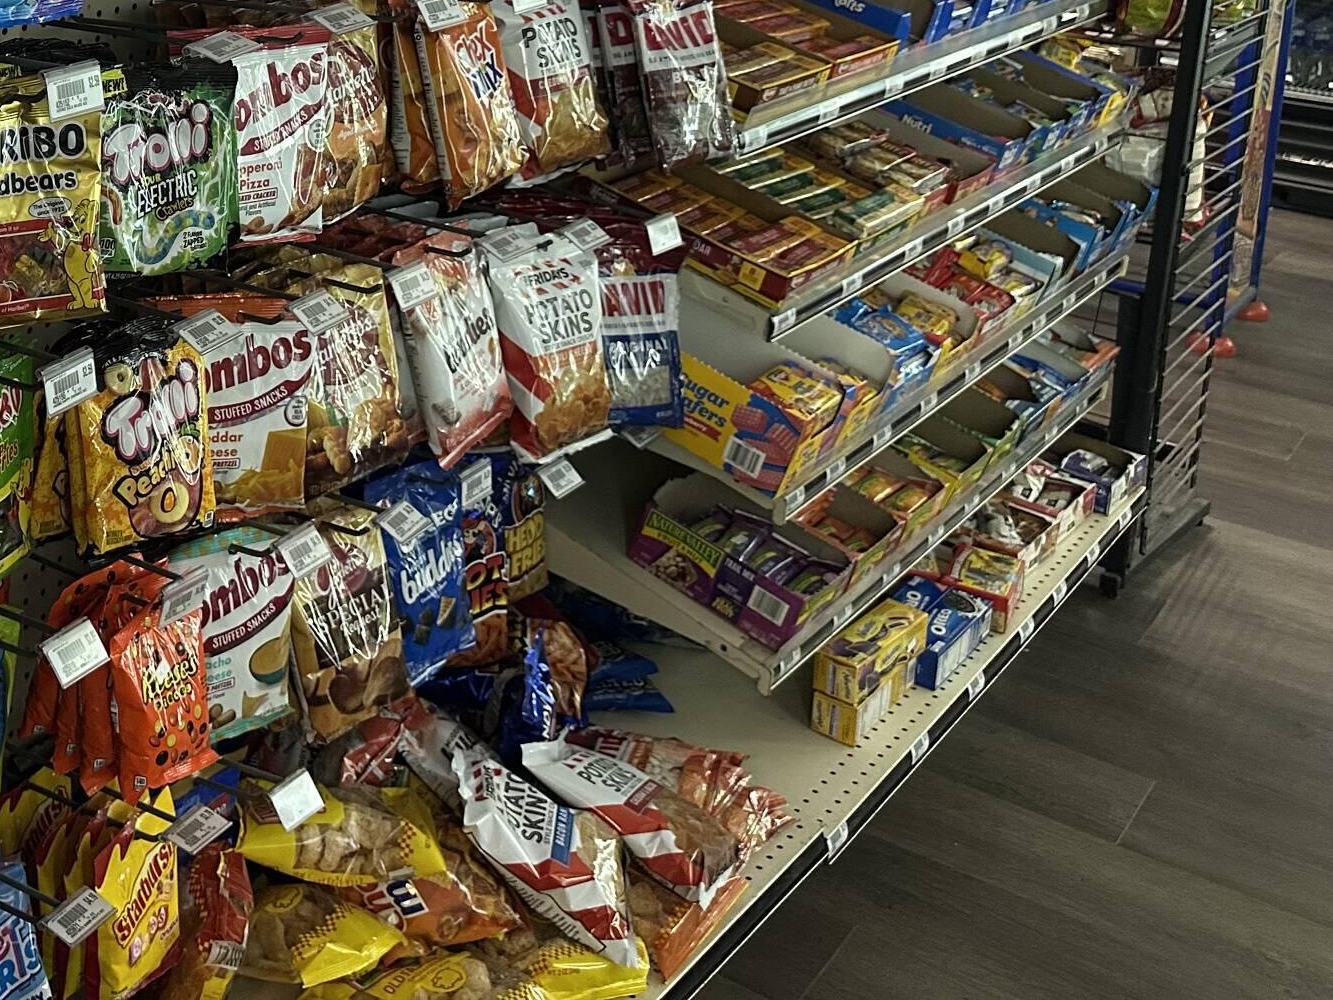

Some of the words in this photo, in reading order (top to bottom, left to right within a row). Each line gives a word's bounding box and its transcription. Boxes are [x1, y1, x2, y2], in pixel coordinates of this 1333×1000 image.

[136, 171, 199, 219] ELECTRIC
[239, 178, 270, 190] Pizza
[155, 198, 194, 222] Crawlers
[525, 288, 595, 324] POTATO
[540, 311, 594, 345] SKINS
[104, 358, 200, 462] Trolli
[214, 403, 252, 422] STUFFED
[254, 385, 289, 411] SNACKS
[648, 514, 687, 544] NATURE
[686, 532, 721, 566] VALLEY
[212, 626, 246, 649] STUFFED
[245, 602, 277, 630] SNACKS
[601, 767, 638, 792] SKINS
